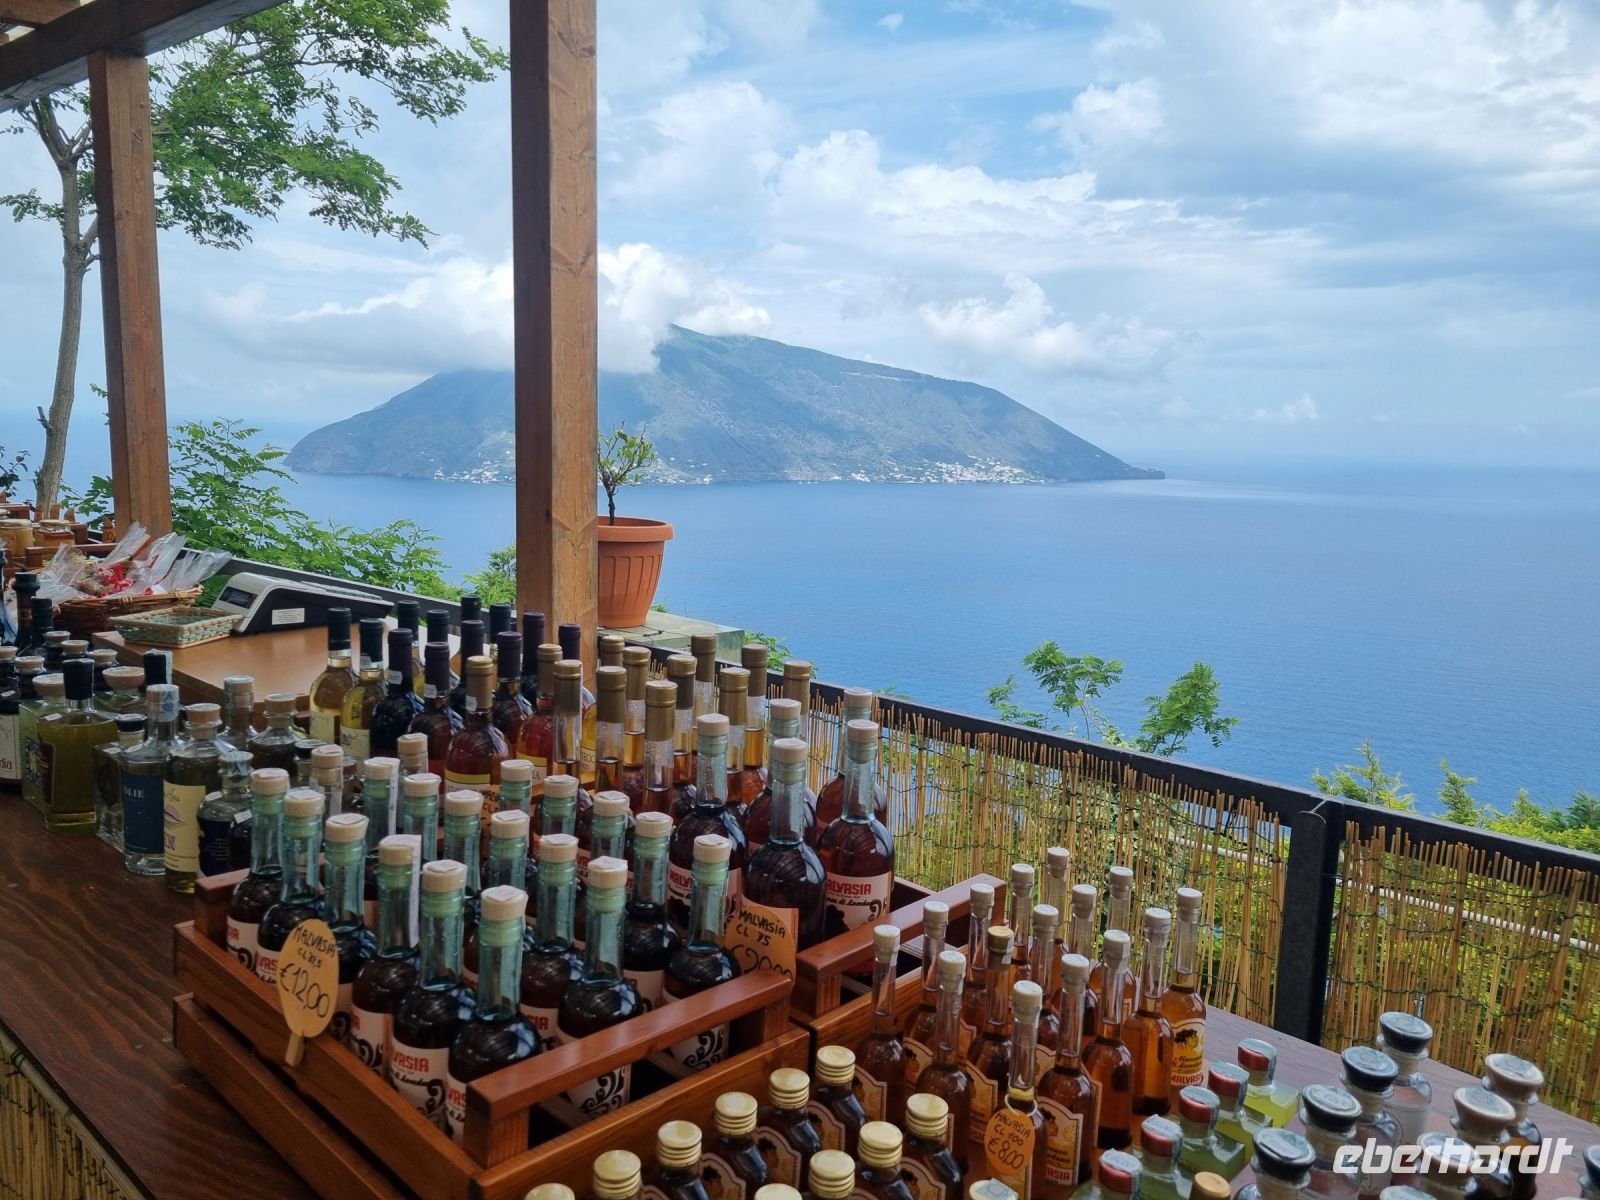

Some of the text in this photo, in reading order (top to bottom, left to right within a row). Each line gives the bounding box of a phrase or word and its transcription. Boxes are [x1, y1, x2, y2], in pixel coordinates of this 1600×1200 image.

[123, 785, 145, 799] OLIE
[826, 880, 872, 896] ALVASIA
[736, 924, 772, 946] CL 75
[392, 1050, 429, 1073] VASIA
[994, 1124, 1005, 1136] CL
[1008, 1132, 1025, 1146] 100
[1046, 1167, 1070, 1181] ASIA
